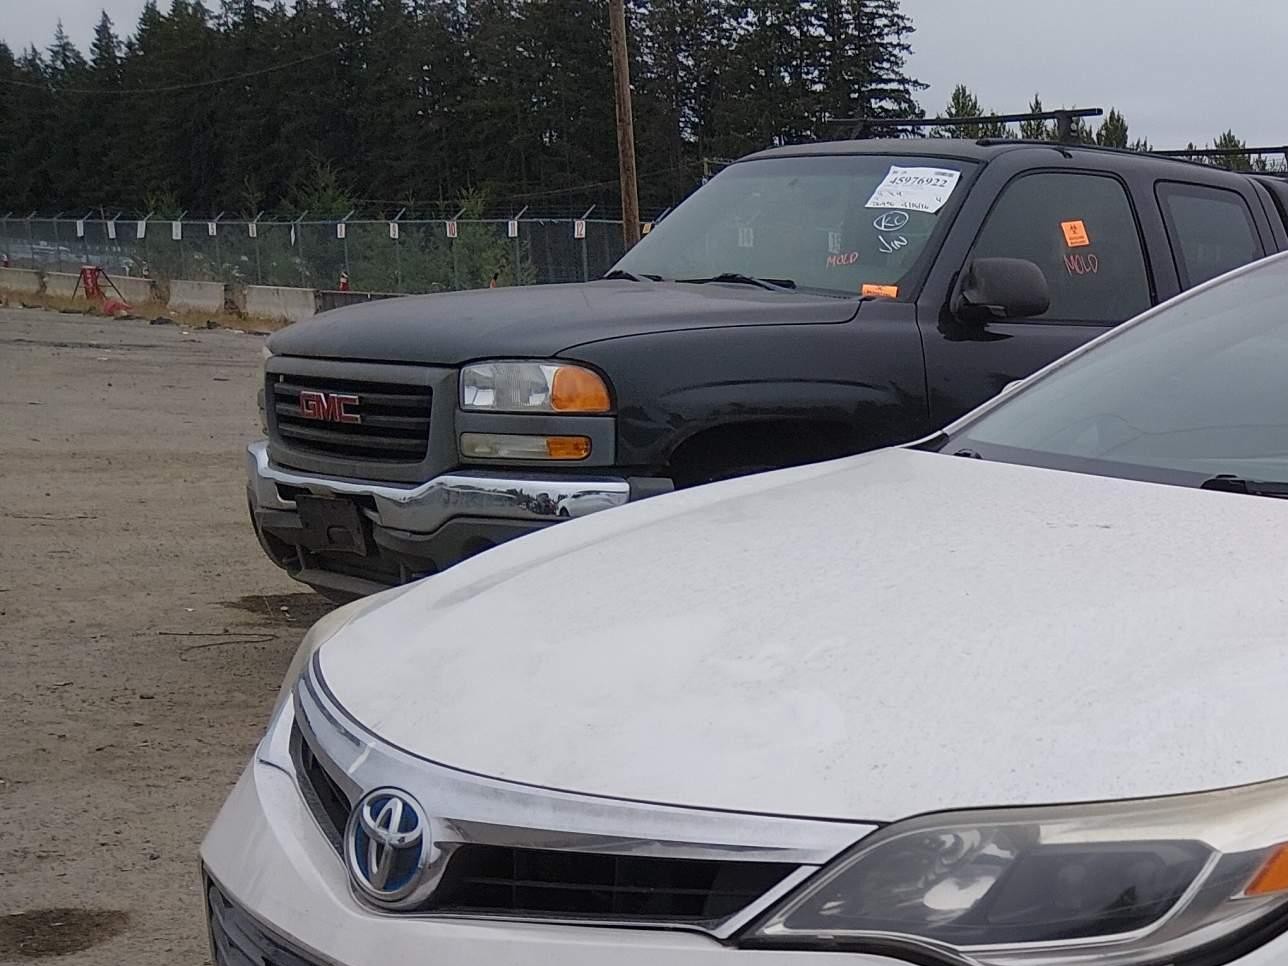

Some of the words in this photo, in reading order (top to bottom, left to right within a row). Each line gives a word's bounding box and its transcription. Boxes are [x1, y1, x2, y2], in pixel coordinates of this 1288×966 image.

[889, 176, 948, 188] 45976922
[448, 222, 456, 236] 10
[576, 222, 584, 236] 12
[301, 390, 361, 424] GMC
